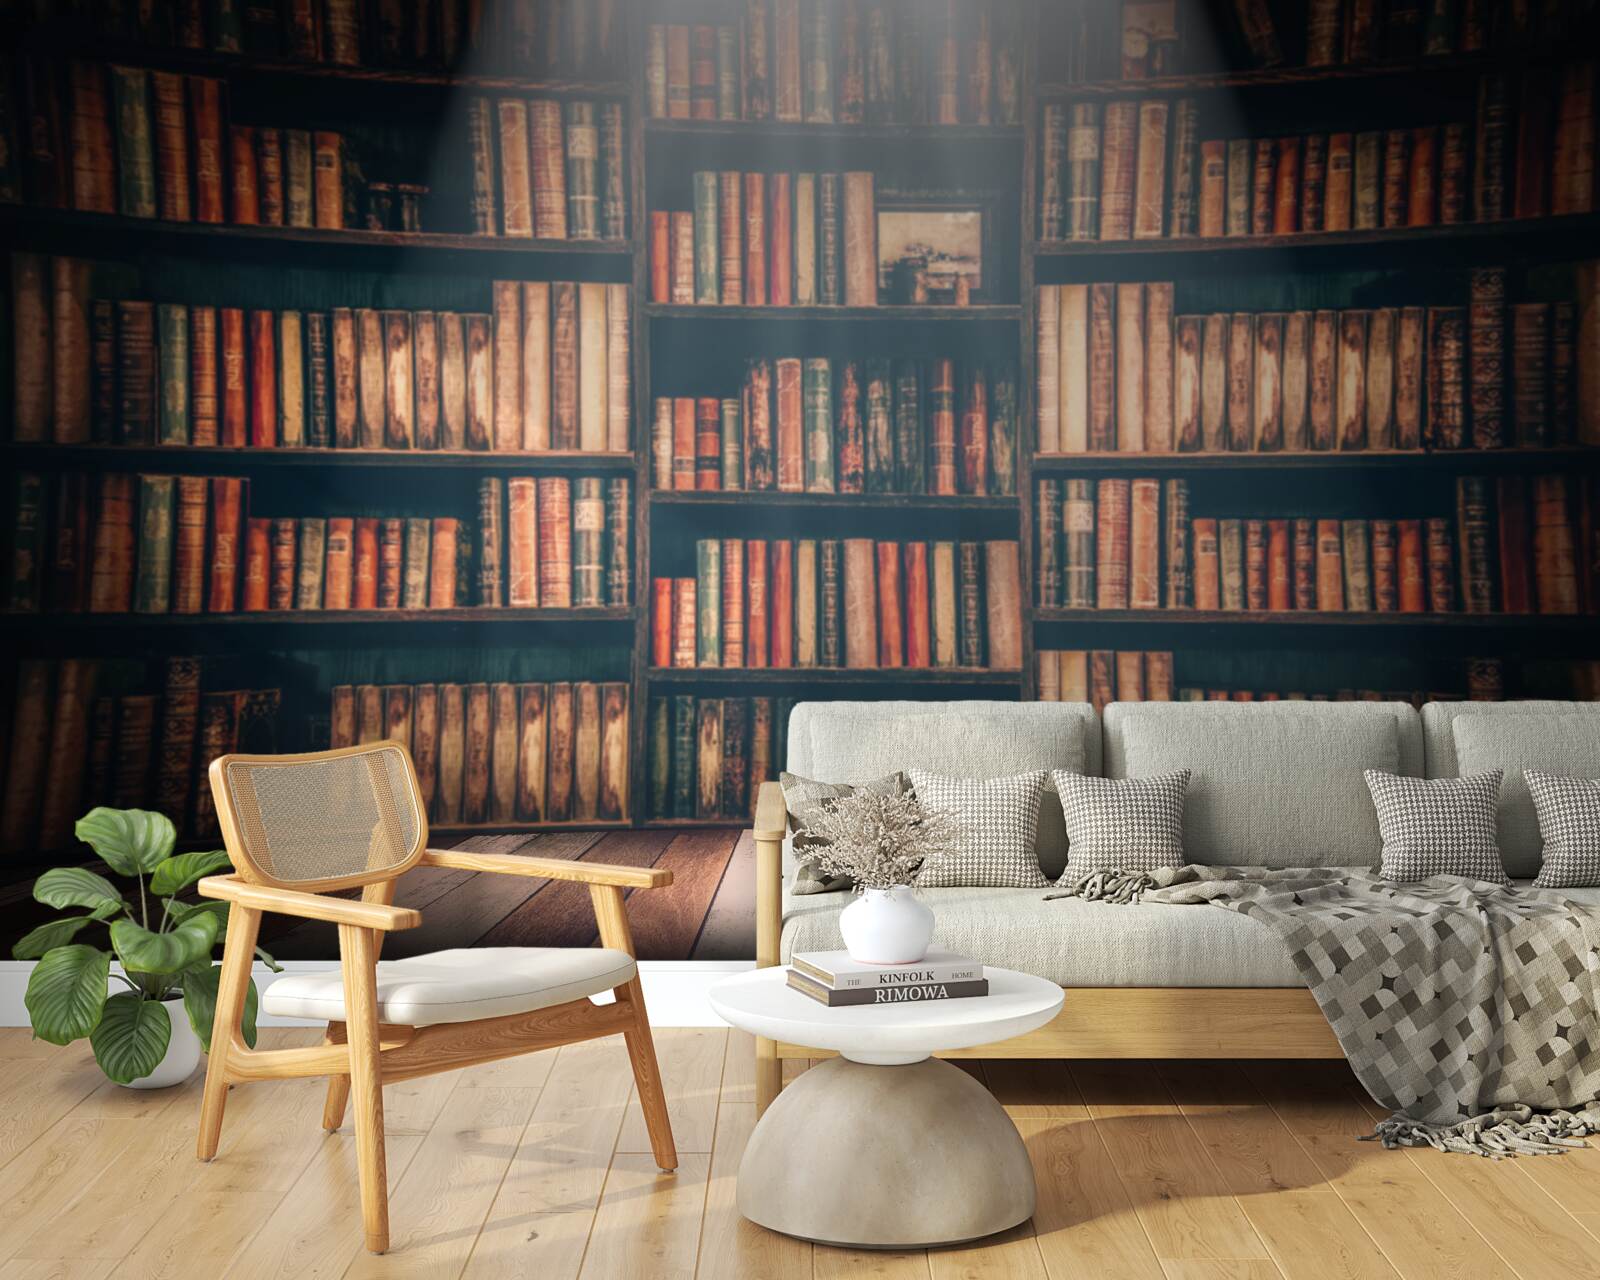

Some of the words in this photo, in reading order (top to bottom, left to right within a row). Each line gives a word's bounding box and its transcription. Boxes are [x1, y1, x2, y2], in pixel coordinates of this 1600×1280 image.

[879, 971, 935, 984] KINFOLK
[952, 971, 974, 979] HOME
[875, 985, 949, 1003] RIMOWA
